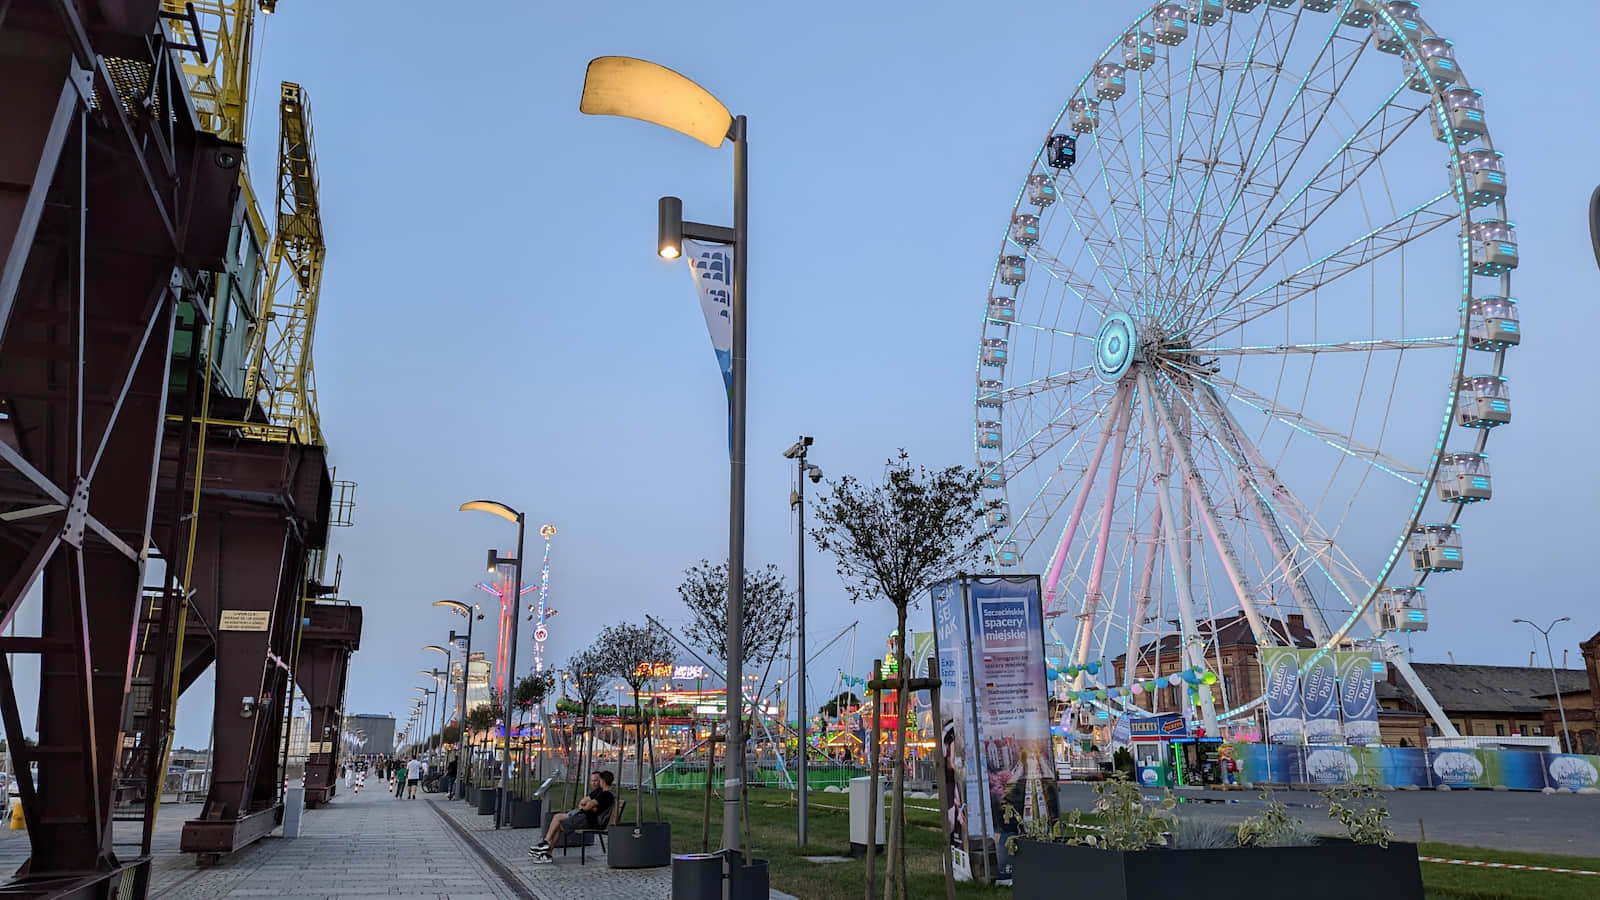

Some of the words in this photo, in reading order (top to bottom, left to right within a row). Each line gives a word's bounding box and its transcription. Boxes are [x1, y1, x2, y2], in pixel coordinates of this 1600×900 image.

[984, 618, 1023, 629] spacery
[986, 629, 1026, 641] miejskie
[1270, 662, 1288, 700] Holiday
[1283, 674, 1296, 697] Park
[1306, 664, 1323, 702] Holiday
[1319, 676, 1333, 698] Park
[1344, 665, 1362, 704] Holiday
[1358, 678, 1372, 700] Park
[1132, 722, 1157, 732] TICKETS
